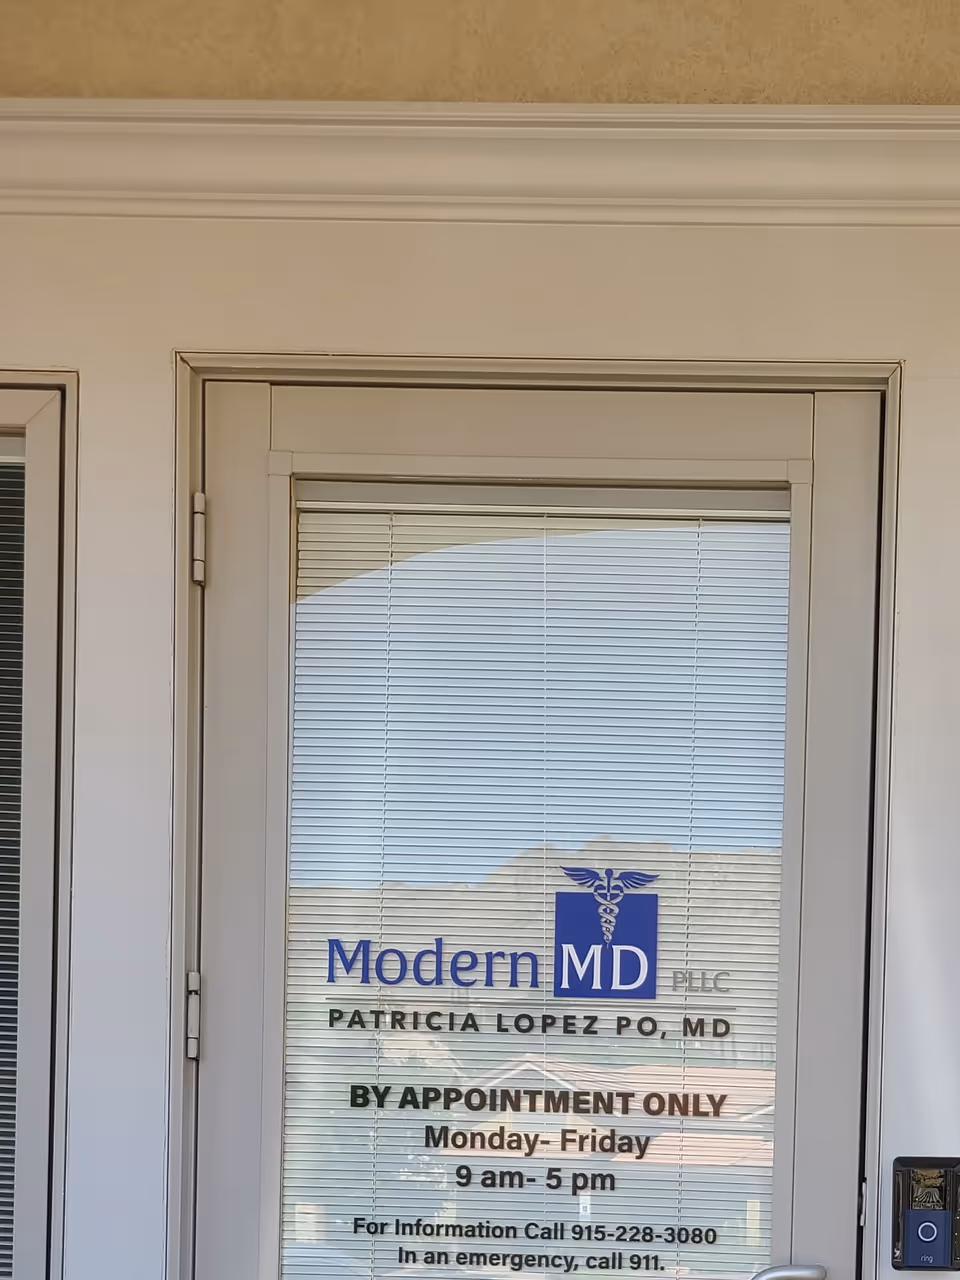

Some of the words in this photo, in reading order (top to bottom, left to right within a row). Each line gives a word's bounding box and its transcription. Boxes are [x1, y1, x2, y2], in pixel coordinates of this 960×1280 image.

[326, 937, 539, 989] Modern
[560, 943, 650, 991] MD
[672, 971, 730, 993] PLLC
[329, 1009, 479, 1032] PATRICIA
[497, 1013, 599, 1035] LOPEZ
[617, 1017, 666, 1039] PO,
[682, 1018, 731, 1038] MD
[350, 1085, 391, 1108] BY
[399, 1087, 635, 1115] APPOINTMENT
[643, 1092, 728, 1117] ONLY
[424, 1125, 551, 1156] Monday-
[560, 1129, 651, 1159] Friday
[455, 1165, 472, 1187] 9
[481, 1170, 537, 1188] am-
[545, 1168, 562, 1190] 5
[571, 1172, 615, 1196] pm
[353, 1218, 389, 1235] For
[394, 1219, 518, 1239] Information
[524, 1221, 565, 1241] Call
[571, 1224, 717, 1245] 915-228-3080
[398, 1247, 416, 1264] In
[424, 1252, 450, 1265] an
[455, 1251, 580, 1272] emergency,
[586, 1252, 623, 1271] call
[629, 1254, 665, 1271] 911.
[920, 1254, 934, 1264] ring
